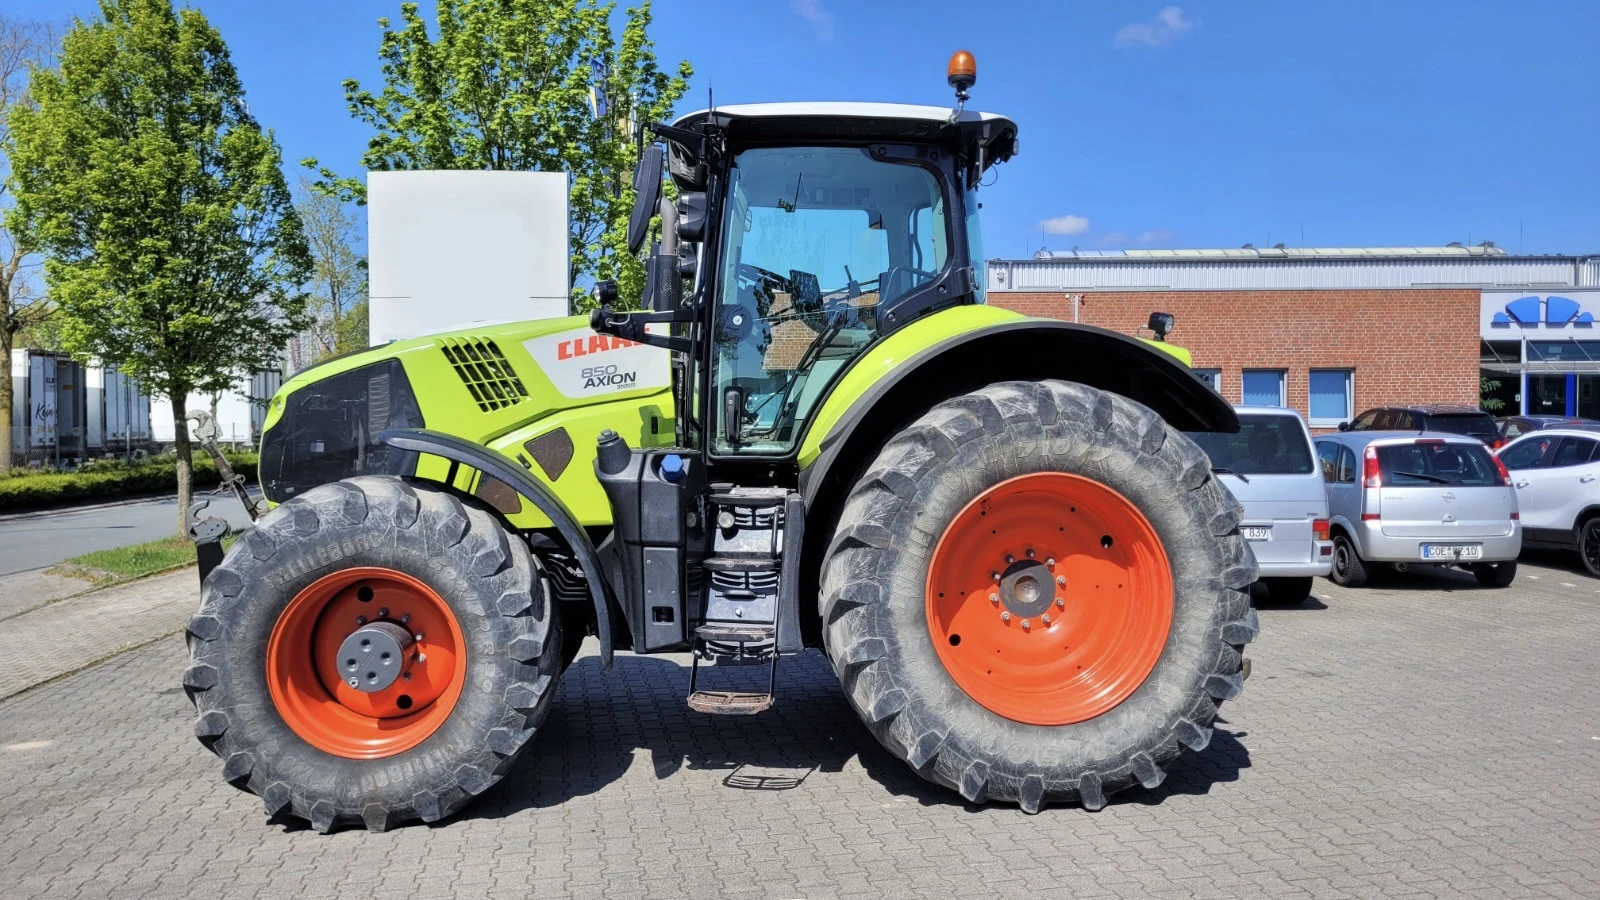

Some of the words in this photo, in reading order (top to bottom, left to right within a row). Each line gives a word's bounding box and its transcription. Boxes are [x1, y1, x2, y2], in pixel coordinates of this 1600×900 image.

[558, 327, 650, 361] CLAA
[581, 364, 618, 378] 850
[583, 371, 636, 389] AXION
[887, 471, 961, 609] TRELLEBORG
[1249, 527, 1267, 538] 839
[1428, 546, 1447, 556] COE
[1466, 546, 1477, 556] 10
